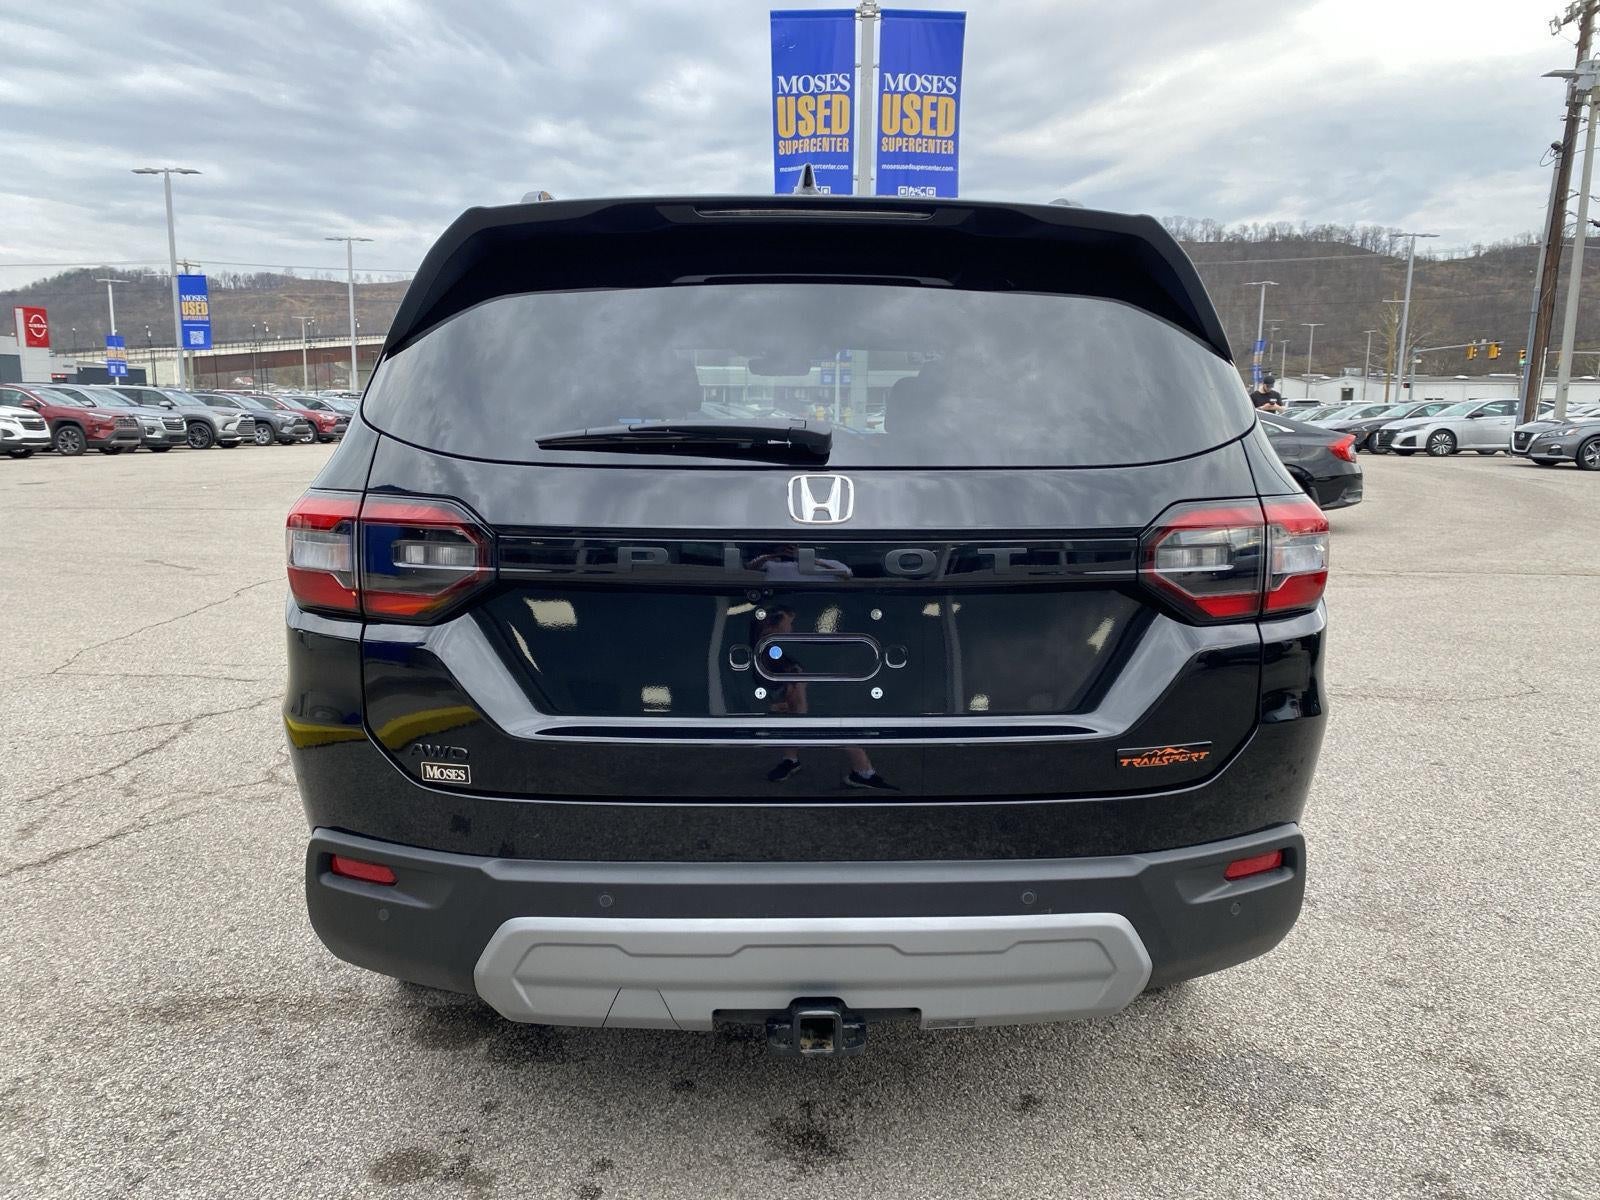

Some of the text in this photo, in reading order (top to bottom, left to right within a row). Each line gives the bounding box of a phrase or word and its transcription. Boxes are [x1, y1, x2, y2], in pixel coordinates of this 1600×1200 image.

[777, 73, 851, 94] MOSES
[883, 72, 957, 95] MOSES
[777, 94, 850, 138] USED
[881, 93, 956, 137] USED
[778, 137, 849, 155] SUPERCENTER
[881, 137, 954, 154] SUPERCENTER
[181, 301, 209, 315] USED
[617, 546, 1028, 576] PILOT
[411, 743, 469, 759] AWD
[1120, 751, 1210, 767] TRAILSPORT
